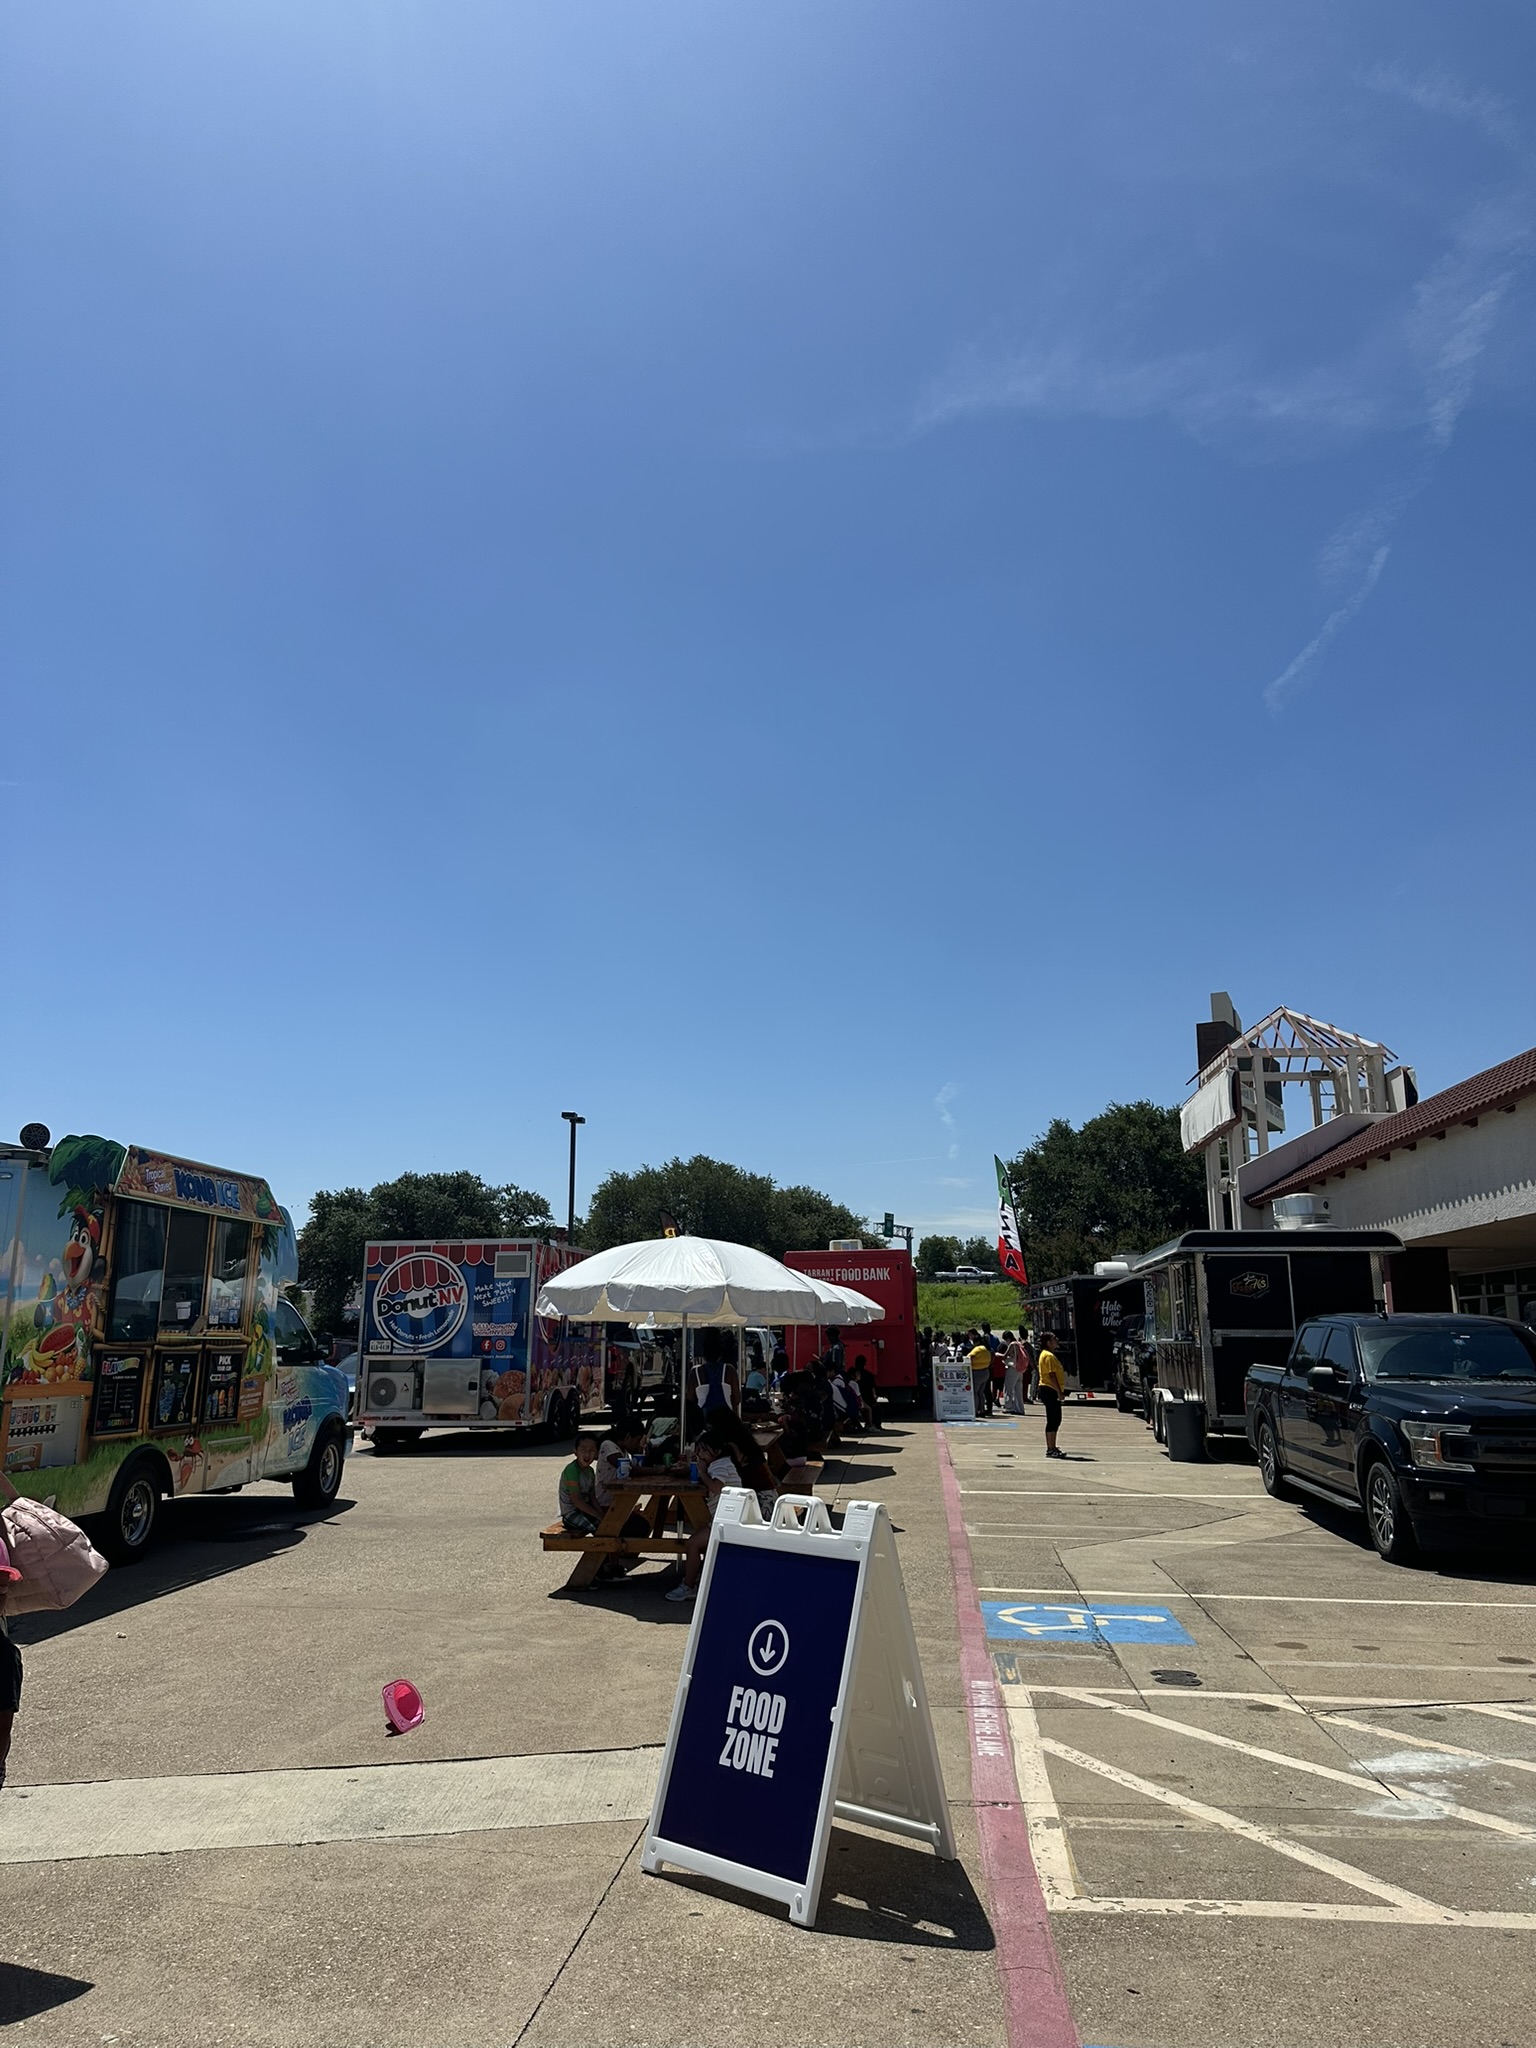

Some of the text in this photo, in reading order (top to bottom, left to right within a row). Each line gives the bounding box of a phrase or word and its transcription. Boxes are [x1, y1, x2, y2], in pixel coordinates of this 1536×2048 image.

[173, 1167, 241, 1211] KONA ICE
[803, 1269, 834, 1278] TARRANT
[835, 1267, 891, 1281] FOOD BANK
[474, 1280, 512, 1293] Make Your
[473, 1287, 517, 1301] Next Party
[481, 1294, 510, 1307] SWEET!
[218, 1355, 232, 1365] PICK
[727, 1685, 786, 1735] FOOD
[718, 1726, 780, 1779] ZONE
[975, 1735, 1005, 1757] LANE
